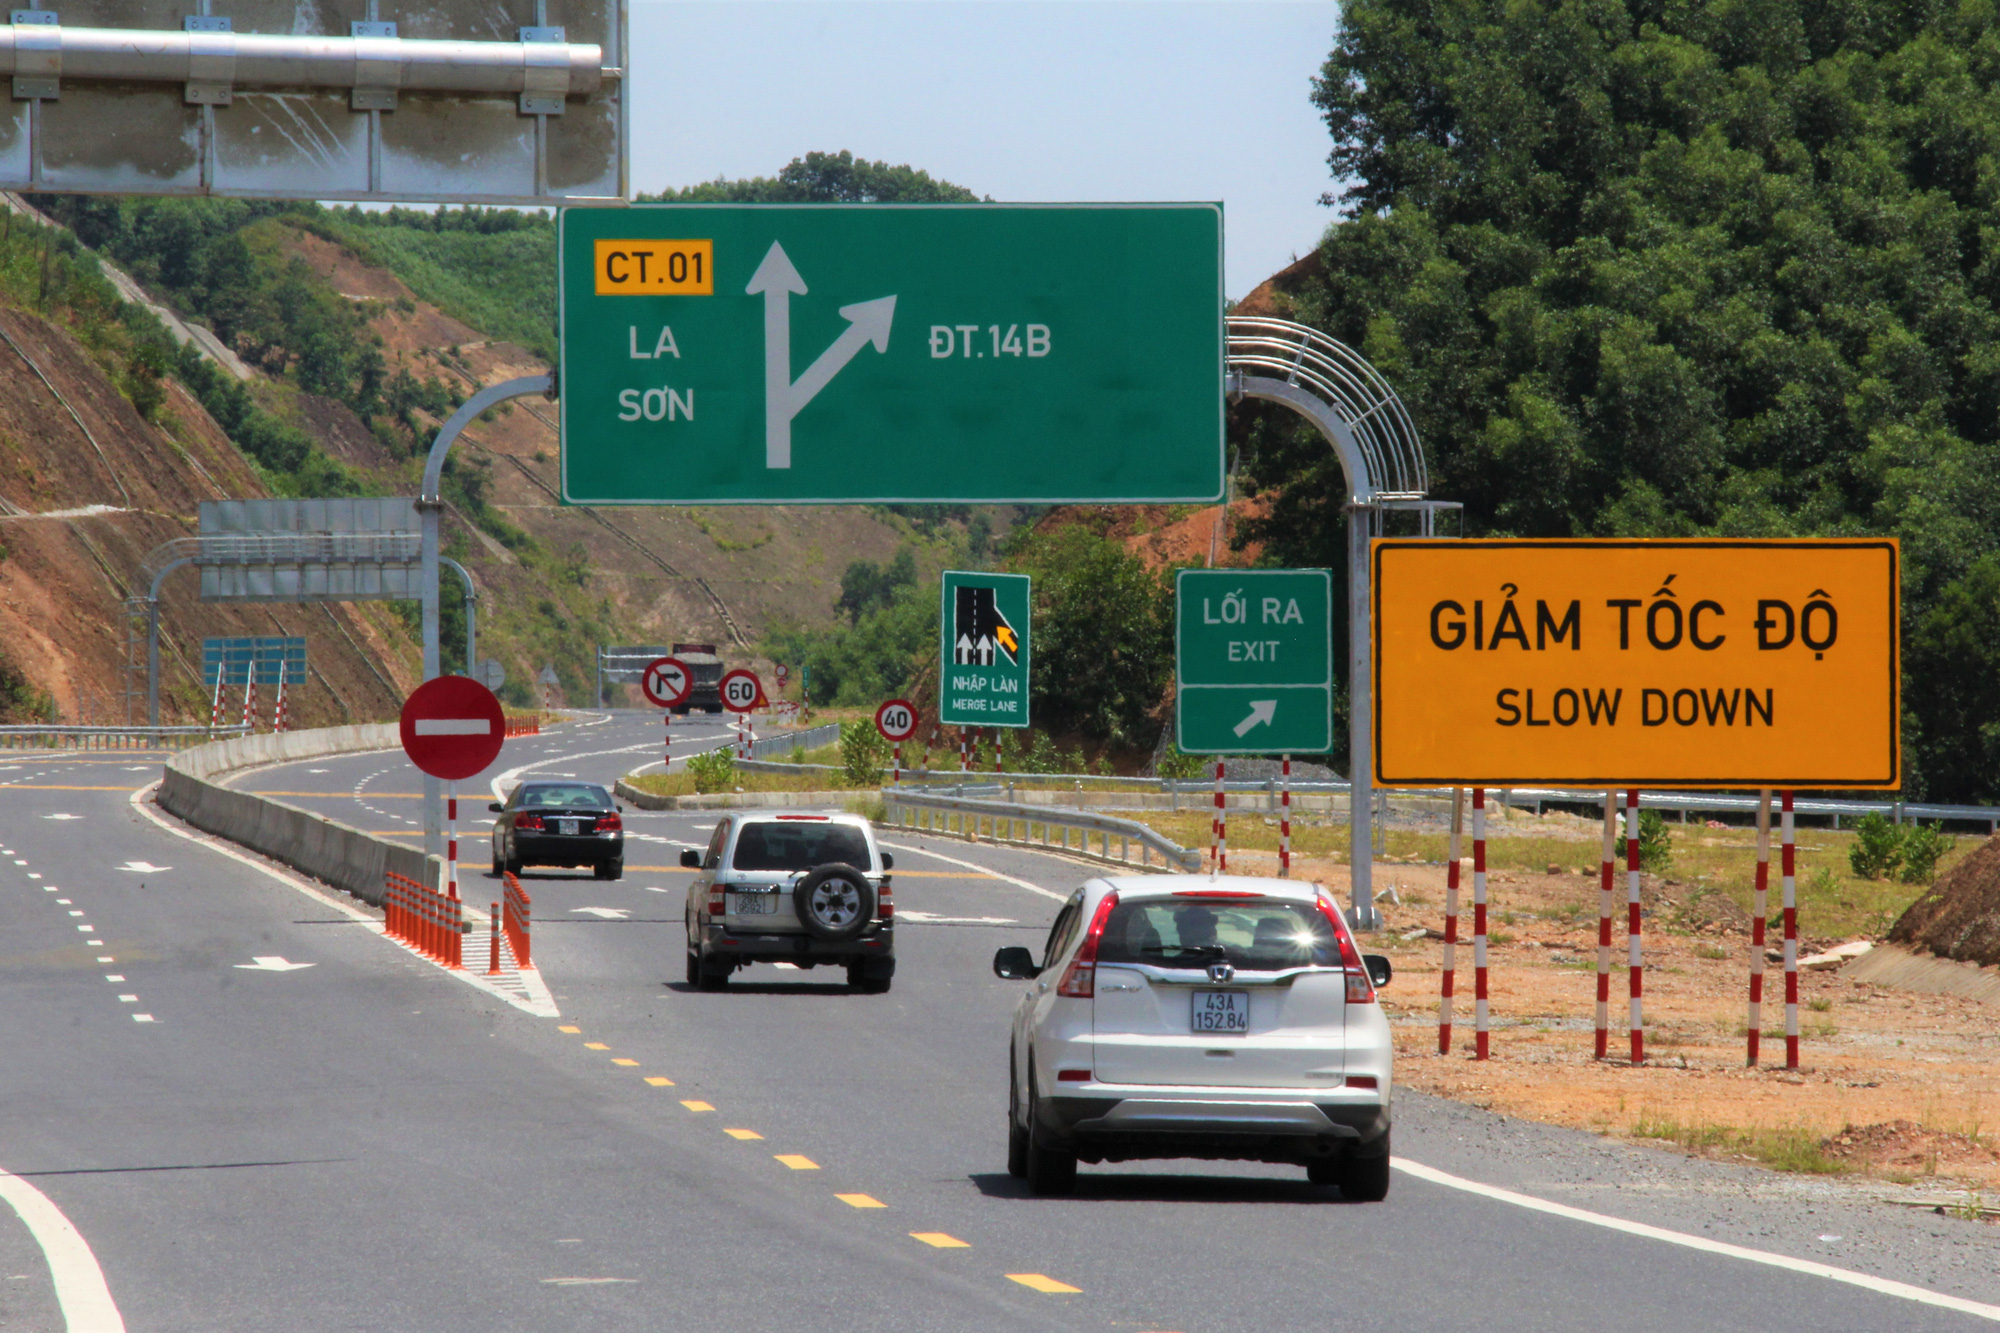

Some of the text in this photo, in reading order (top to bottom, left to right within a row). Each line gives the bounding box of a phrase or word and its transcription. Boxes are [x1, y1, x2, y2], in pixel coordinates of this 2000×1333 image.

[606, 251, 702, 284] CT.01
[629, 325, 681, 359] LA
[929, 323, 1051, 359] ĐT.14B
[618, 385, 694, 422] SƠN
[1203, 588, 1304, 625] LỐI RA
[1430, 574, 1838, 661] GIẢM TỐC ĐỘ
[1228, 640, 1281, 662] EXIT
[728, 682, 753, 701] 60
[952, 673, 1018, 694] NHẬP LÀN
[952, 698, 1018, 713] MERGE LANE
[1495, 687, 1773, 727] SLOW DOWN
[884, 710, 908, 729] 40
[1206, 994, 1235, 1011] 43A
[1196, 1012, 1246, 1030] 152.84
